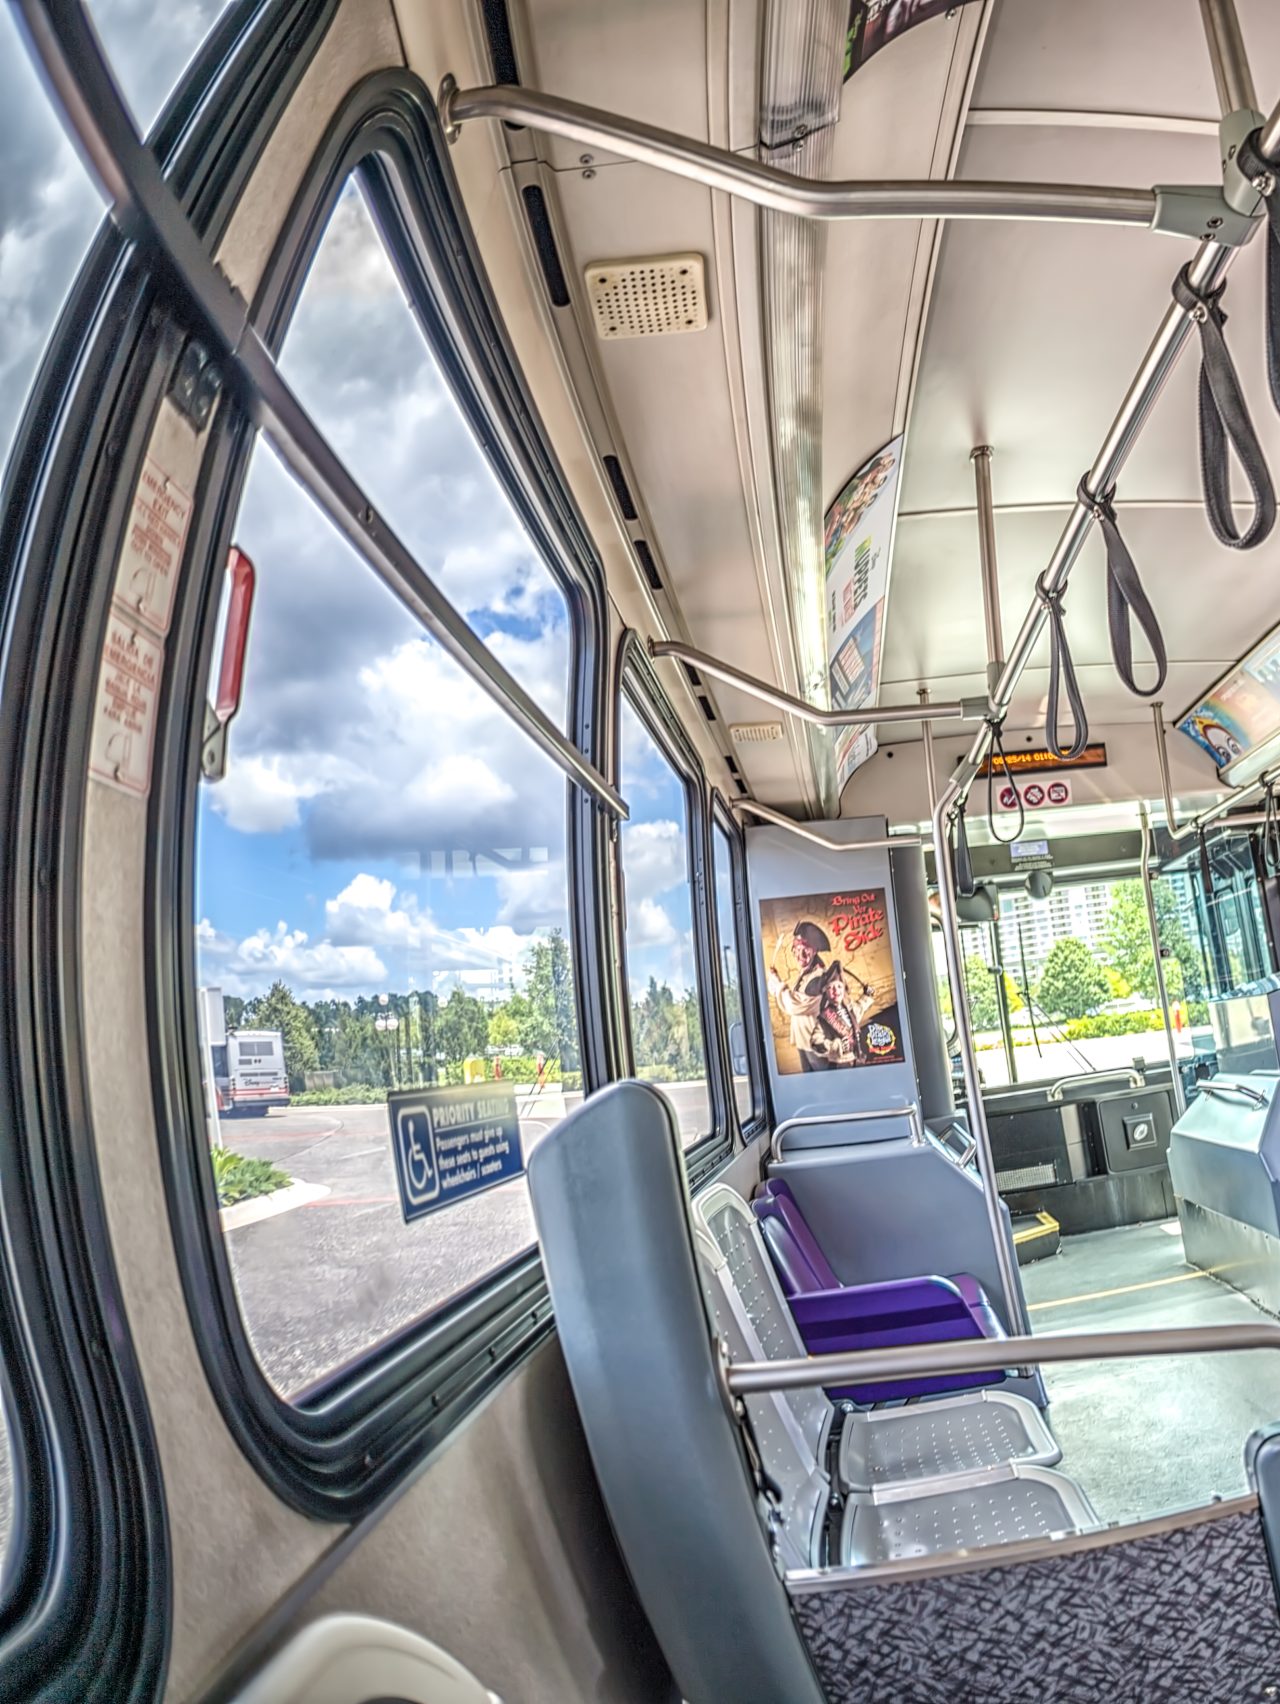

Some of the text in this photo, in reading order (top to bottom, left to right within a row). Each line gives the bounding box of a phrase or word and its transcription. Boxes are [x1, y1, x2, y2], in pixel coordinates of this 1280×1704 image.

[831, 907, 885, 936] Pirate
[432, 1102, 475, 1128] PRIORITY
[435, 1134, 469, 1150] Passengers
[469, 1128, 483, 1141] must
[483, 1123, 495, 1142] give
[438, 1140, 509, 1170] these seats to guests using
[441, 1167, 476, 1188] wheelchairs
[481, 1159, 502, 1175] scooters
